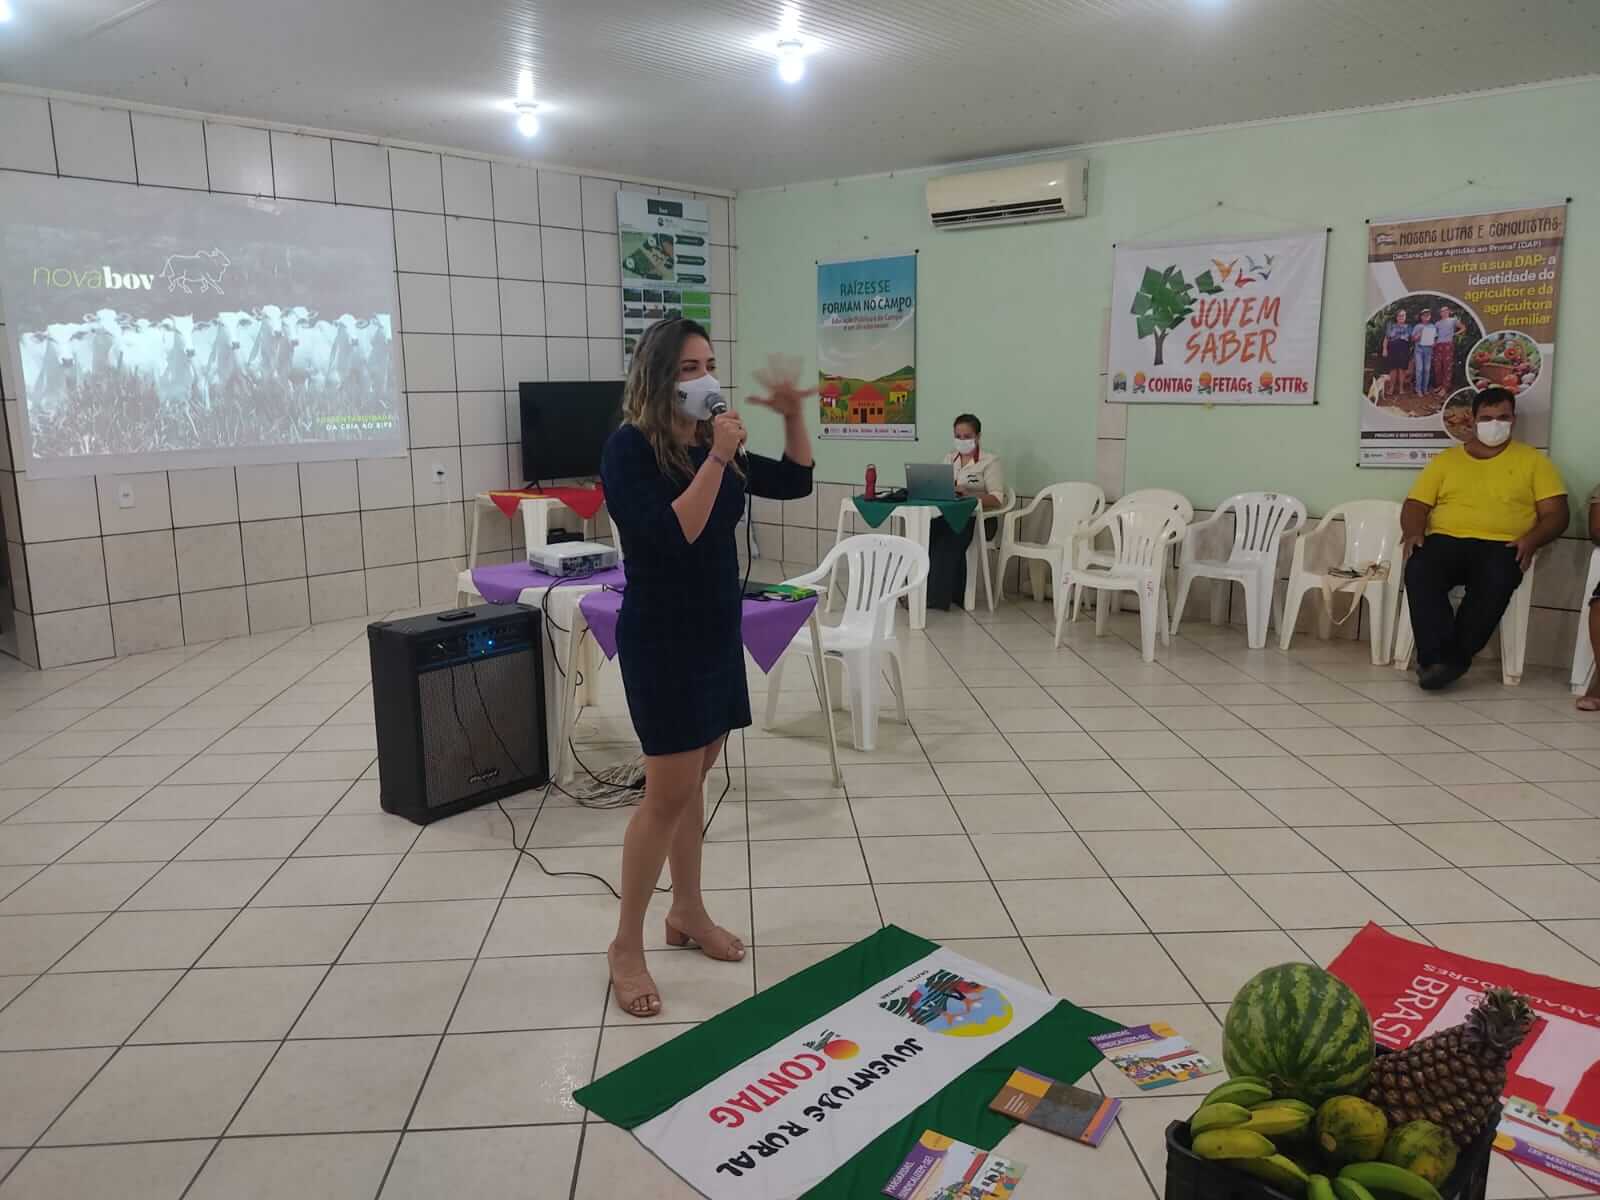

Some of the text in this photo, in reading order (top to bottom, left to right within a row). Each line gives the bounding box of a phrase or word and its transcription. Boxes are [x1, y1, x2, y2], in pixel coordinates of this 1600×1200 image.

[1400, 229, 1437, 247] NOSSAS
[1441, 224, 1473, 243] LUTAS
[1478, 225, 1485, 239] E
[1489, 217, 1559, 238] CONQUISTAS
[1441, 254, 1556, 273] Emita a sua DAP: a
[1468, 268, 1555, 286] identidade do
[840, 279, 891, 297] RAÍZES SE
[1464, 285, 1524, 303] agricultor
[1527, 286, 1535, 296] e
[822, 297, 912, 315] FORMAM NO CAMPO
[1190, 296, 1281, 329] JOVEM
[1484, 299, 1553, 316] agricultora
[1504, 313, 1552, 327] familiar
[1184, 329, 1278, 365] SABER
[1148, 376, 1308, 394] CONTAG FETAGs STTRs
[1373, 975, 1449, 1045] BRASI
[708, 1053, 826, 1128] CONTAG
[716, 1120, 809, 1177] RURAL
